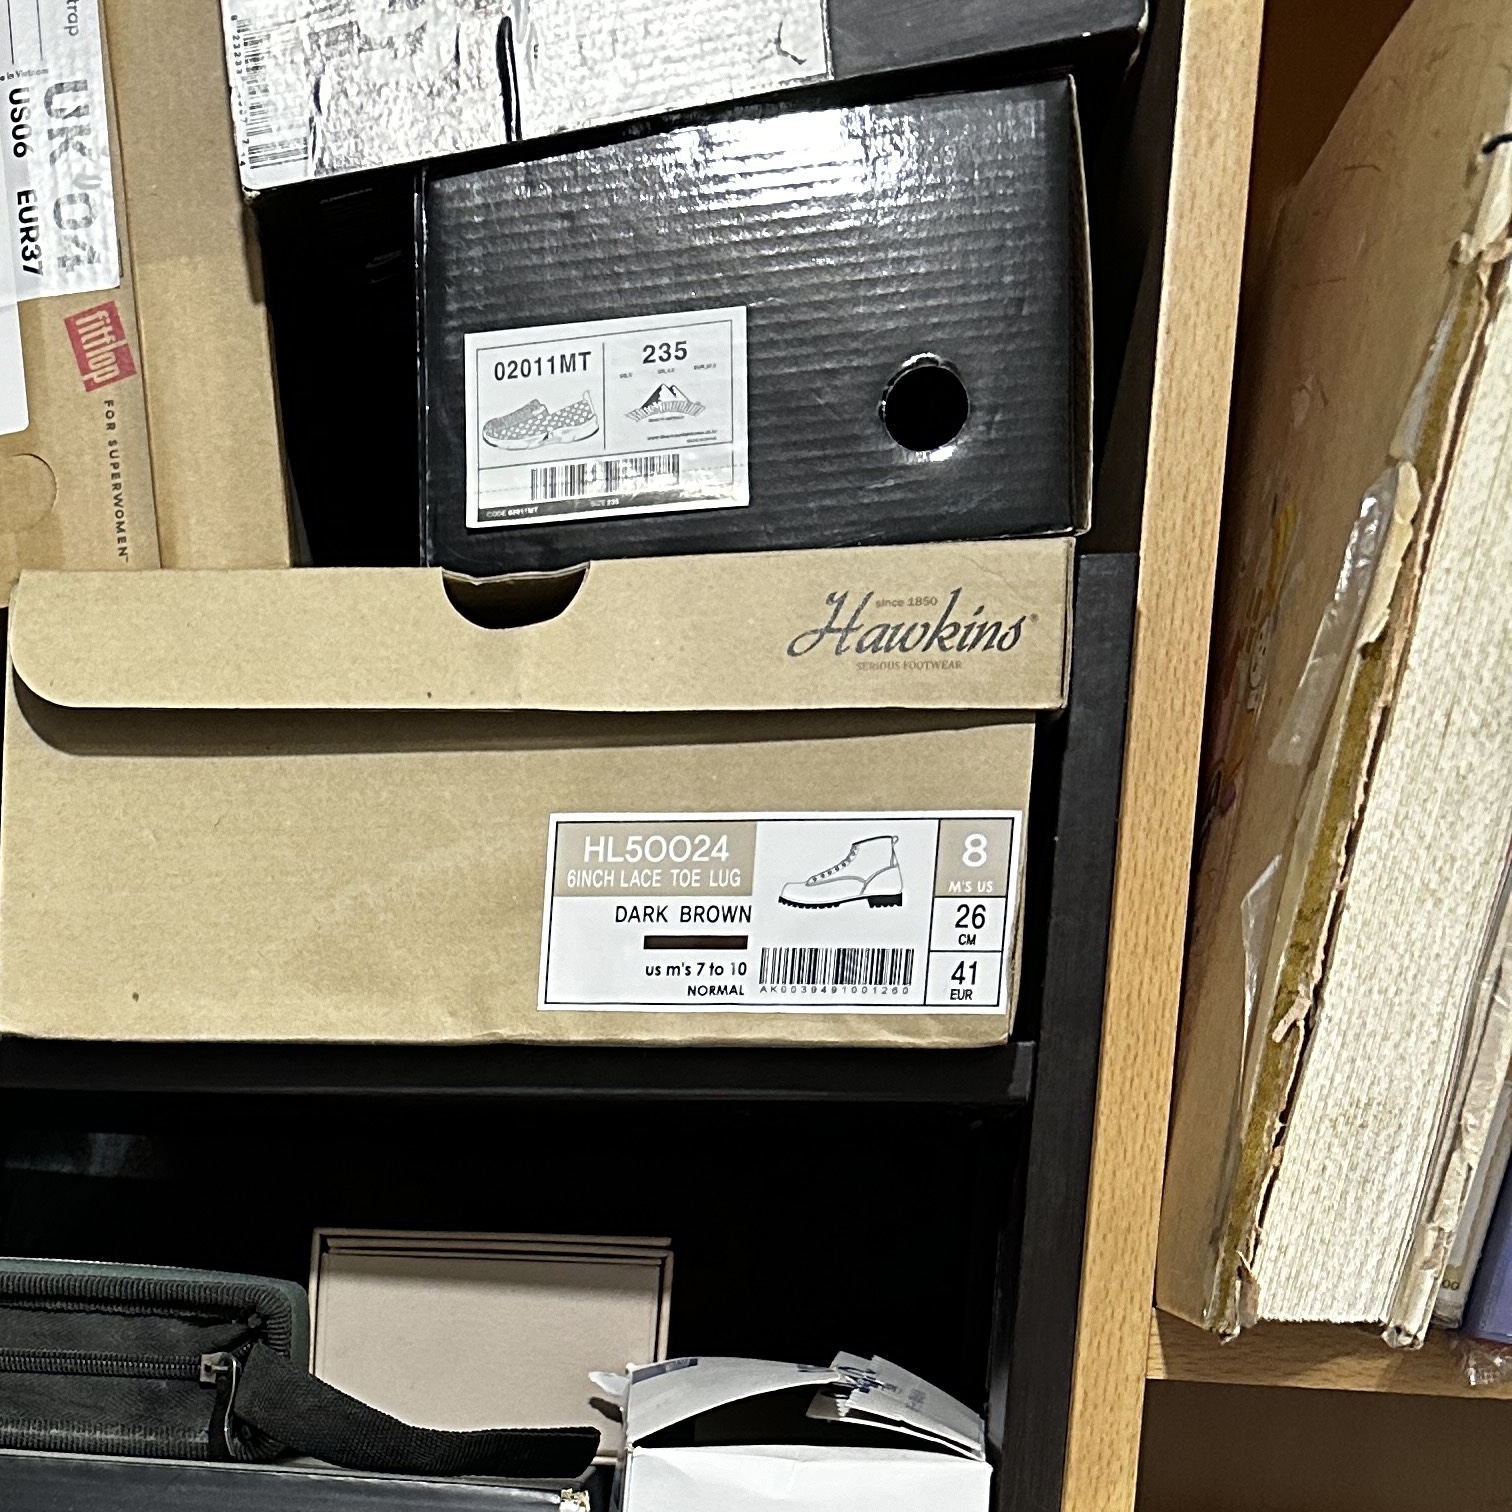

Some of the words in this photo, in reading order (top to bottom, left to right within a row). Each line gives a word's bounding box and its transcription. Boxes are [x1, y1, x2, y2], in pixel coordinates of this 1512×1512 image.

[9, 86, 32, 158] US06
[17, 188, 43, 277] EUR37
[76, 310, 127, 383] fitflop
[643, 341, 687, 364] 235
[494, 352, 591, 381] 02011MT
[104, 400, 115, 430] FOR
[787, 587, 1026, 657] Hawkins
[962, 833, 987, 867] 8
[567, 869, 614, 887] 6INCH
[620, 869, 662, 887] LACE
[671, 869, 700, 887] TOE
[710, 868, 741, 887] LUG
[949, 880, 972, 893] M'S
[977, 880, 993, 893] US
[615, 905, 668, 923] DARK
[680, 905, 752, 923] BROWN
[955, 904, 986, 929] 26
[958, 934, 976, 946] CM
[646, 964, 661, 976] us
[666, 962, 691, 976] m's
[697, 962, 705, 976] 7
[710, 963, 724, 976] to
[731, 962, 747, 976] 10
[951, 961, 978, 986] 41
[687, 985, 744, 996] NORMAL
[950, 988, 973, 1000] EUR
